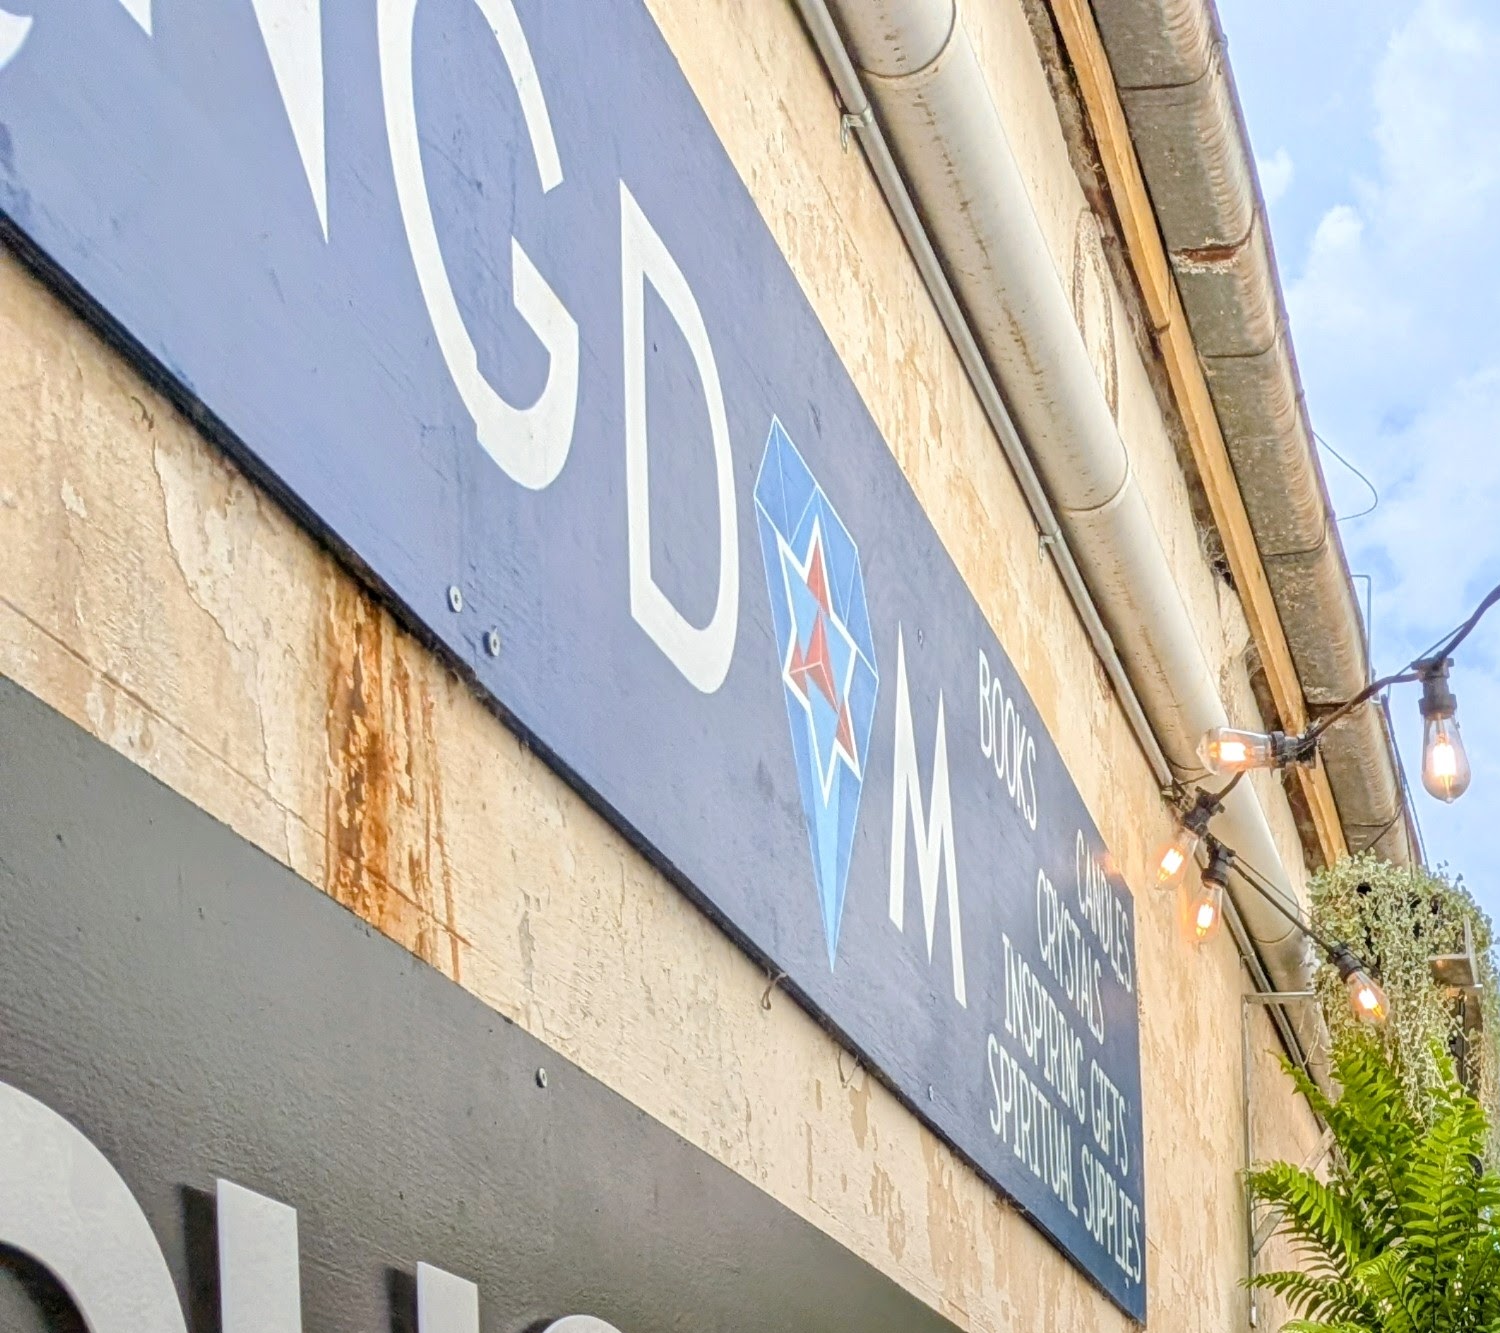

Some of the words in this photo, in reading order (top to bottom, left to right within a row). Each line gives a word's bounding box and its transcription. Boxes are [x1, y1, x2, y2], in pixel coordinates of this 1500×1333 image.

[979, 648, 1037, 830] BOOKS
[1037, 868, 1105, 1044] CRYSTALS
[1076, 828, 1133, 992] CANDLES
[1002, 932, 1086, 1125] INSPIRING
[1091, 1058, 1129, 1176] GIFTS
[988, 1033, 1078, 1217] SPIRITUAL
[1081, 1144, 1142, 1284] SUPPLIES
